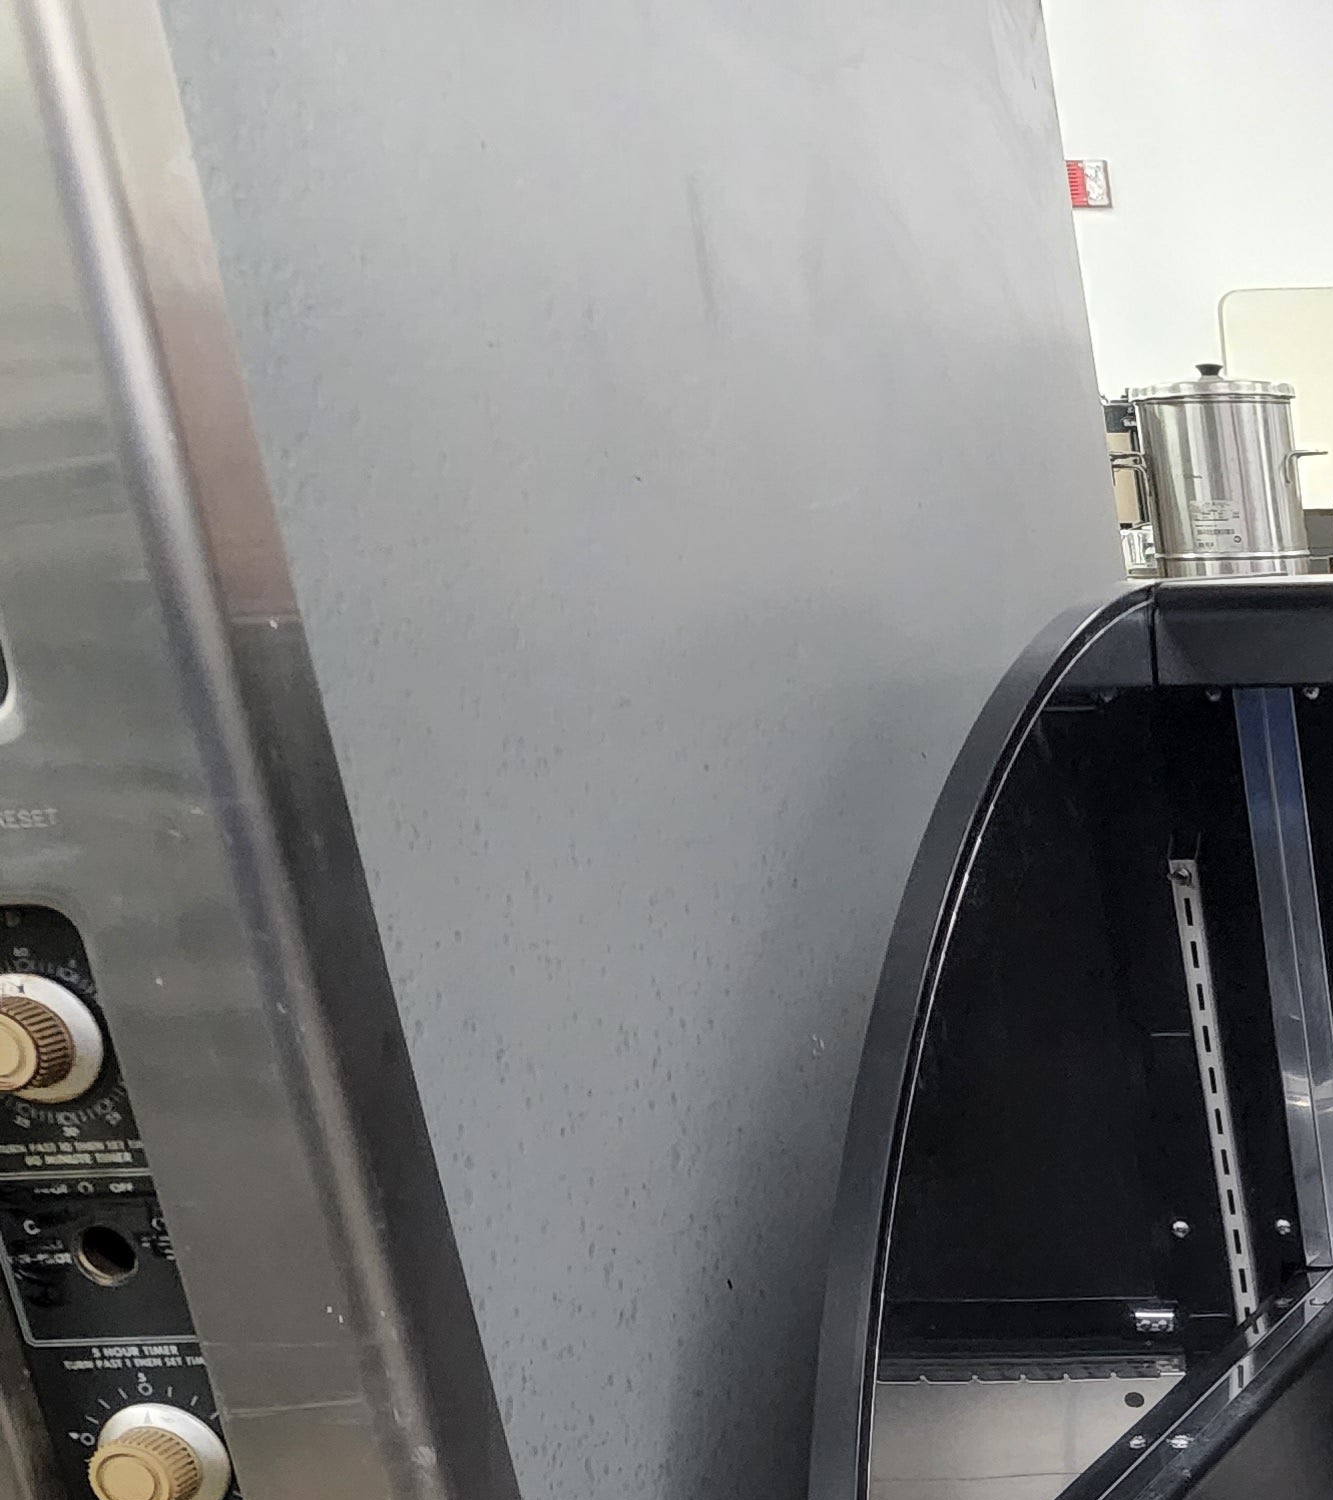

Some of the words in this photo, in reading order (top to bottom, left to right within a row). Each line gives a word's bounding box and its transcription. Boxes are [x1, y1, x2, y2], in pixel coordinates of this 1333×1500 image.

[0, 808, 59, 828] ESET
[103, 1346, 140, 1357] HOUR
[143, 1345, 179, 1356] TIMER
[97, 1358, 123, 1369] PAST
[165, 1356, 183, 1366] SET
